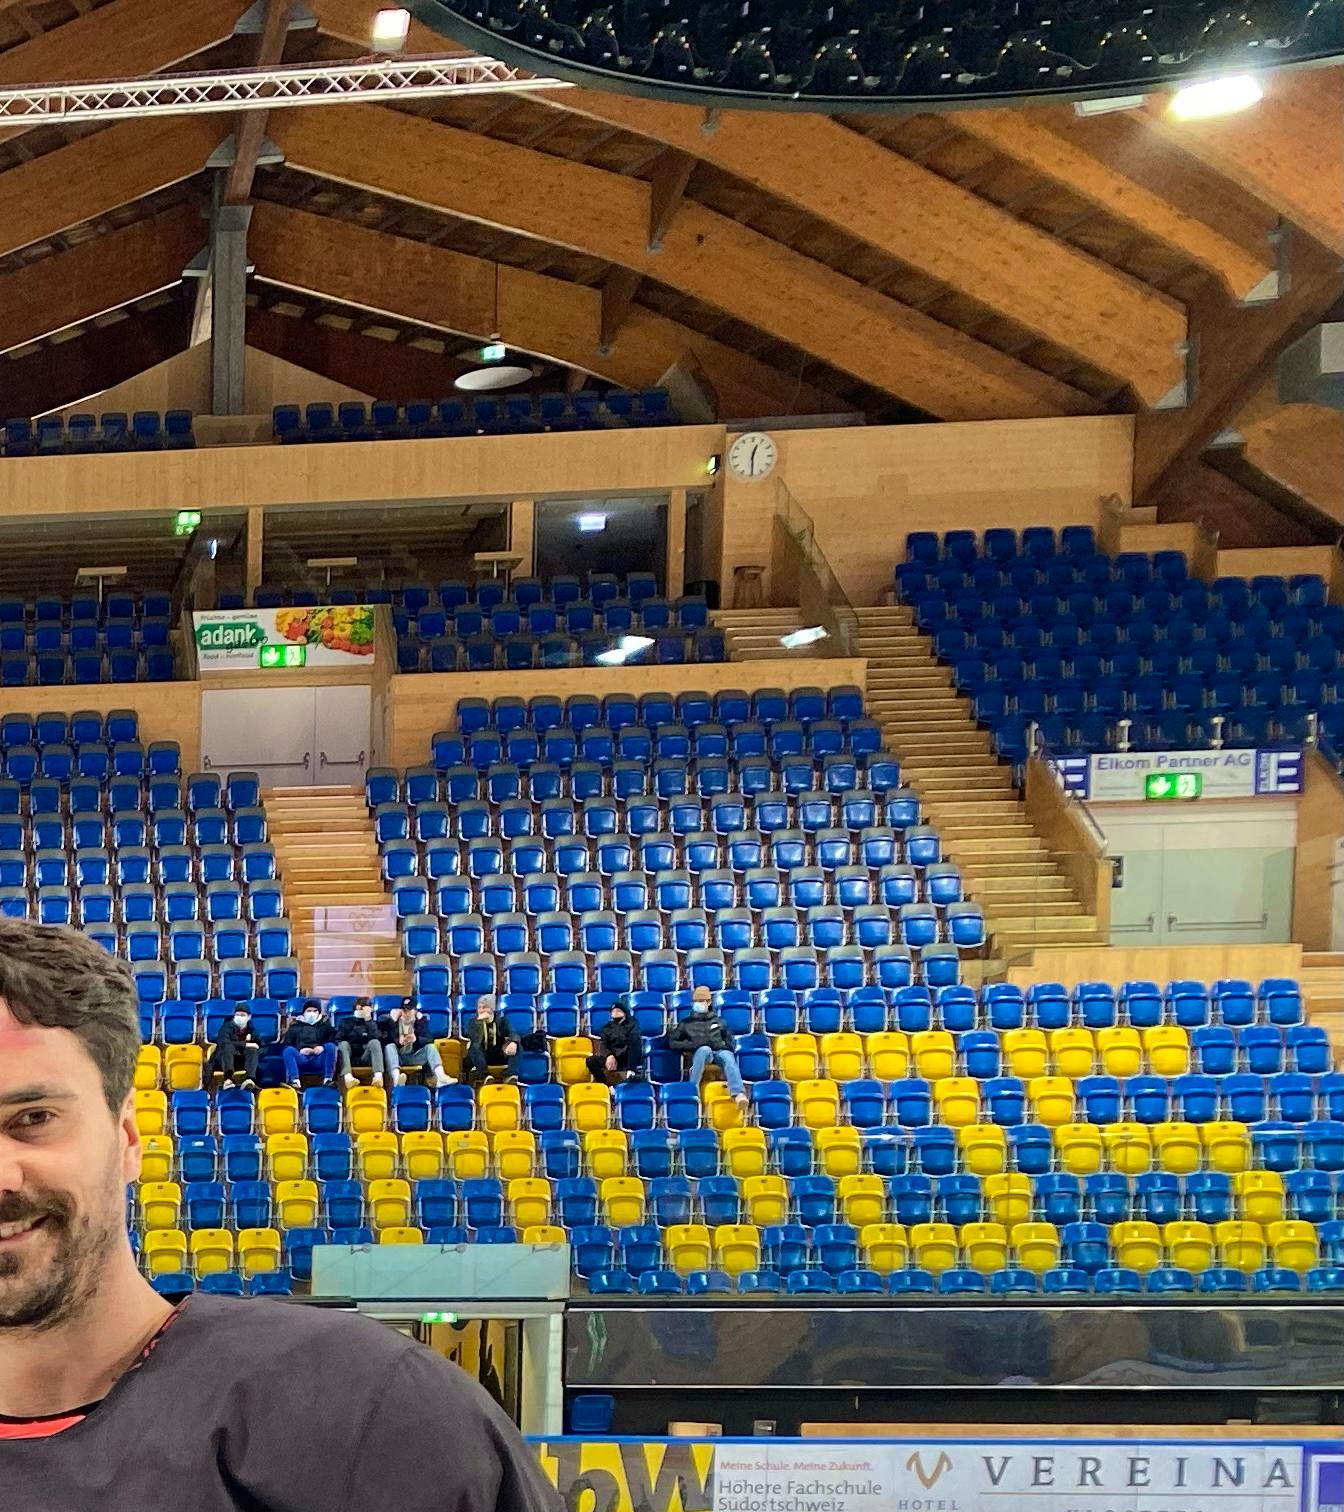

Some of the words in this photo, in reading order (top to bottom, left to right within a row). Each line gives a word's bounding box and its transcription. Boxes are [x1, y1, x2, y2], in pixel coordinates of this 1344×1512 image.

[1097, 757, 1150, 770] Elkom
[1156, 755, 1219, 769] Partner
[1224, 753, 1251, 766] AG
[720, 1461, 752, 1472] Meine
[793, 1461, 827, 1472] Meine
[829, 1460, 873, 1472] Zukunft.
[982, 1455, 1296, 1488] VEREINA
[719, 1477, 782, 1496] Höhere
[787, 1478, 883, 1497] Fachschule
[898, 1499, 960, 1511] HOTEL
